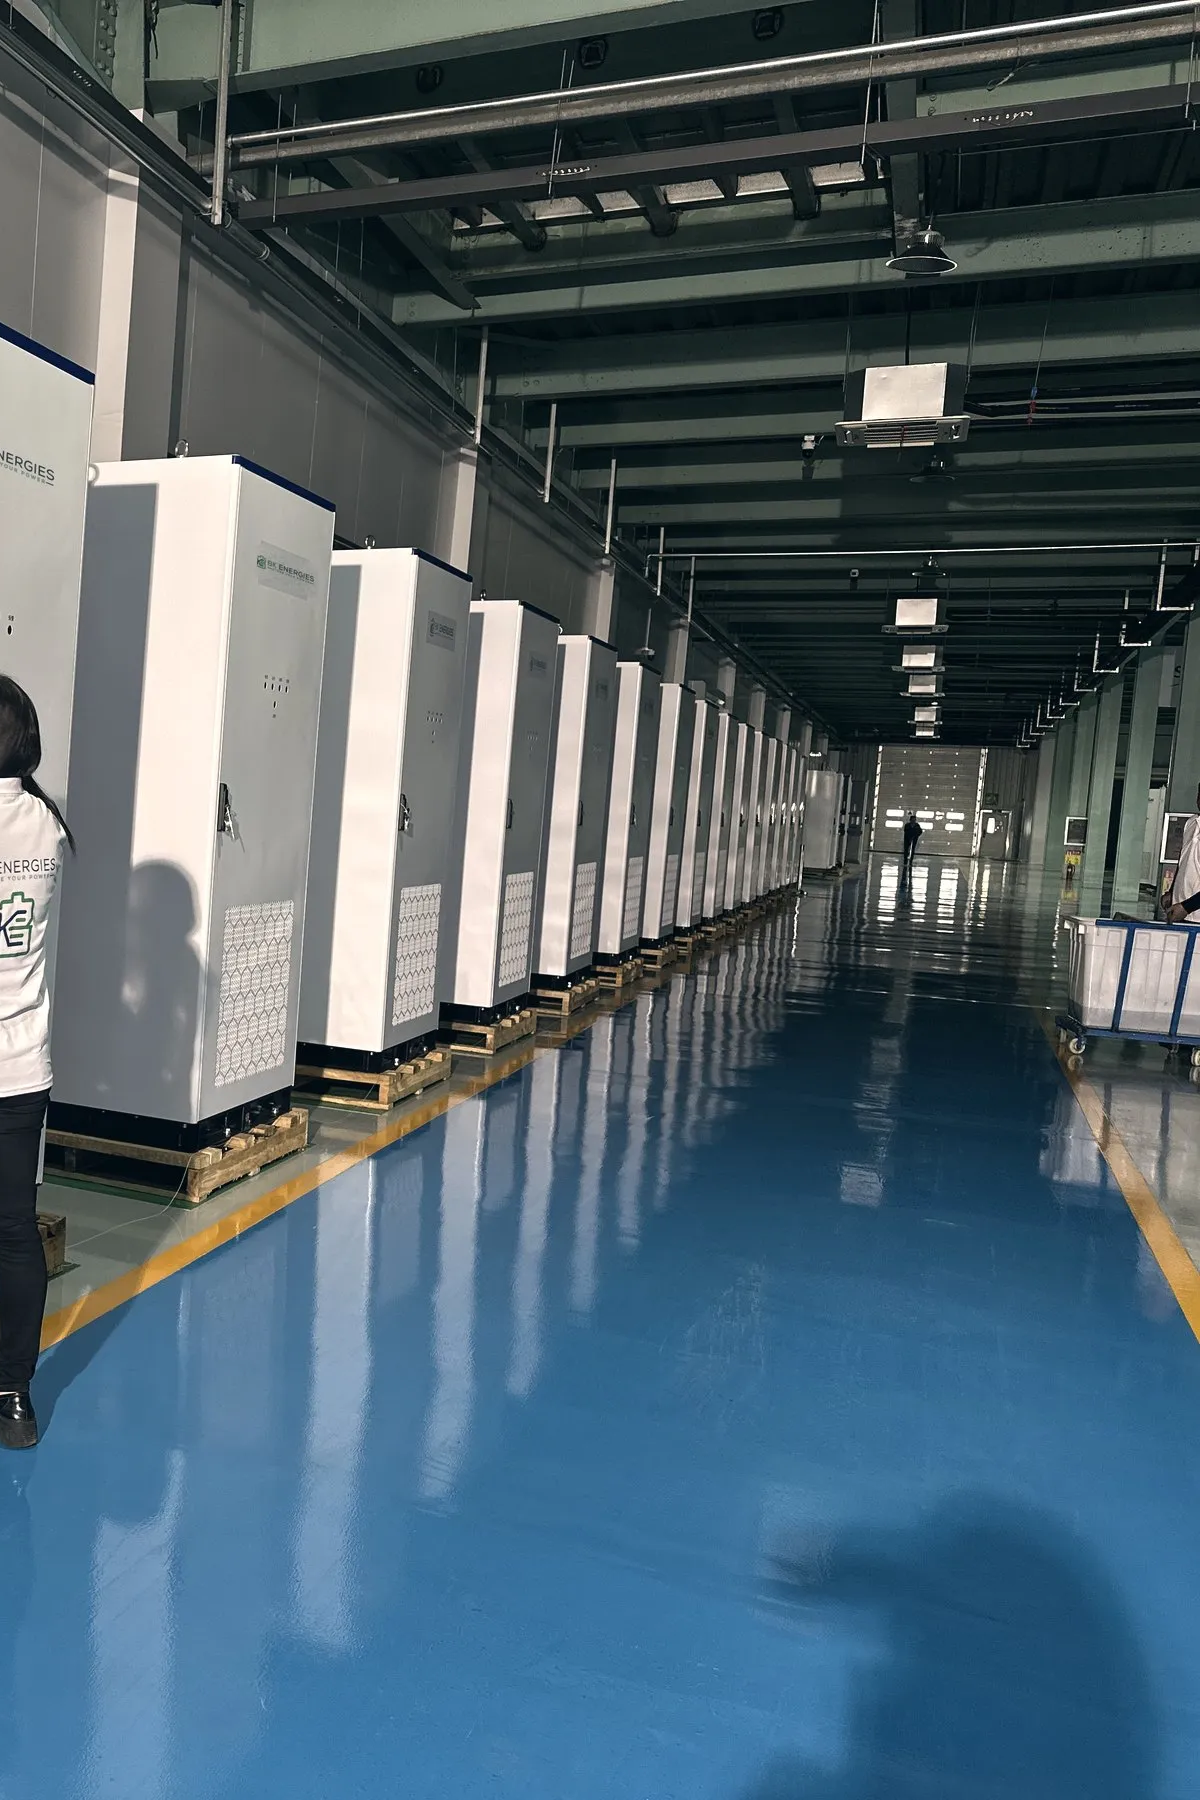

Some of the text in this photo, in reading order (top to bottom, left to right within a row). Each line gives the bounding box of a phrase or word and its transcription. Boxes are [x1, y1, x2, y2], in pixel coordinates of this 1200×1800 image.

[0, 461, 18, 474] YOUR
[21, 470, 46, 484] POWER
[278, 563, 315, 582] ENERGIES
